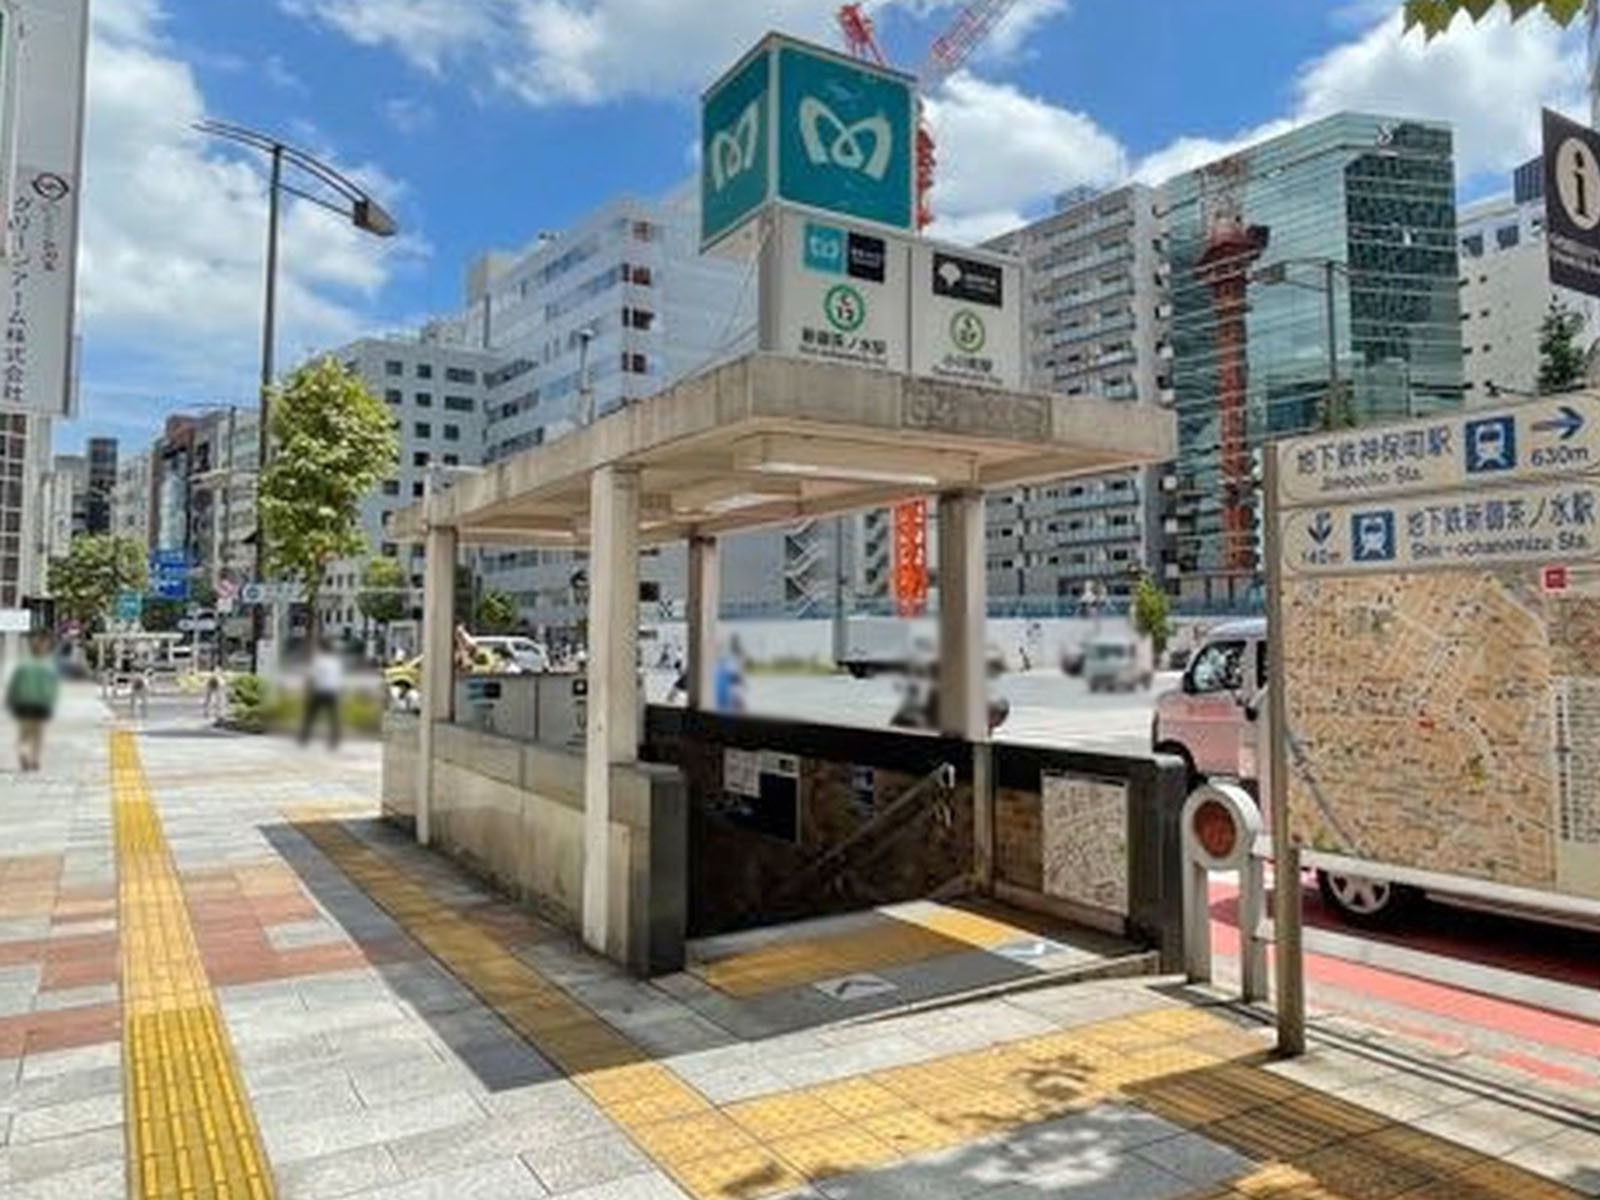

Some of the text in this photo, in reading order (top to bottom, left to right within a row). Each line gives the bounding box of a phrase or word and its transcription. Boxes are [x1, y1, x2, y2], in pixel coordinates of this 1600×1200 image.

[1297, 424, 1453, 474] 地下鉄神保町駅
[1531, 445, 1589, 467] 630m
